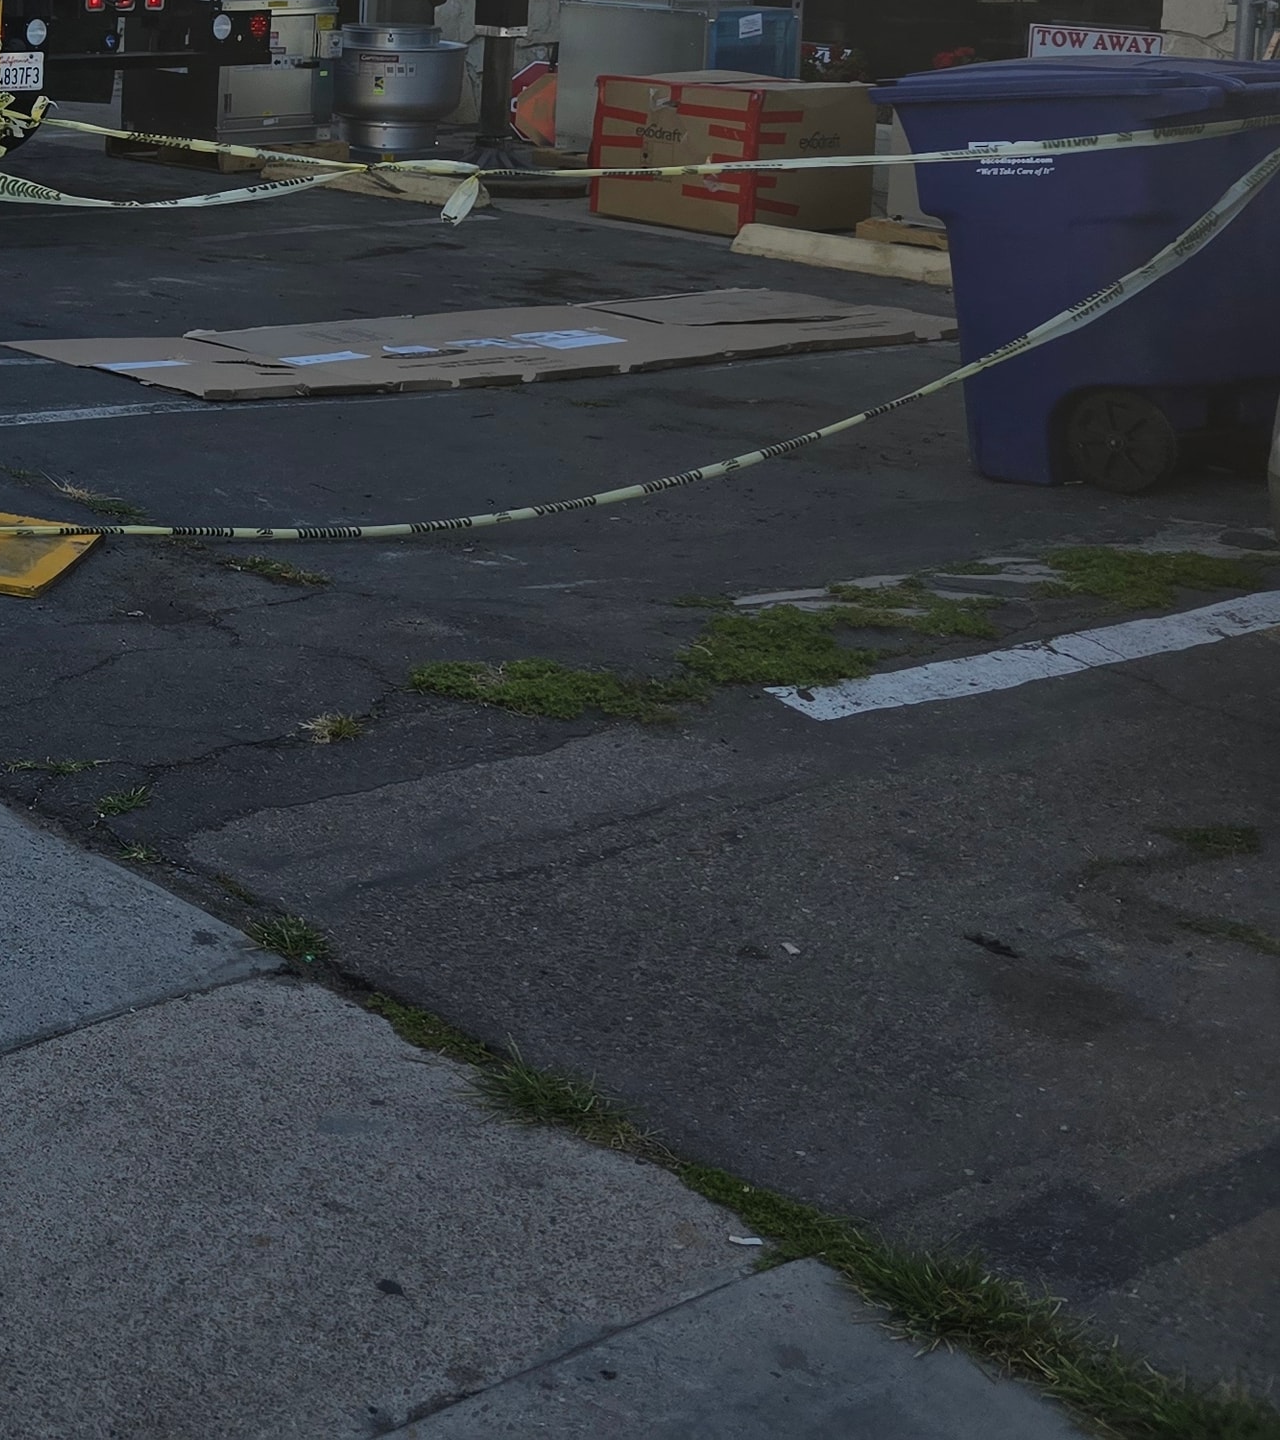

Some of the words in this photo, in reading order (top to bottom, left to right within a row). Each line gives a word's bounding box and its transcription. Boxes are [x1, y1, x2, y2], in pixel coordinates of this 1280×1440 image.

[1037, 29, 1089, 49] TOW
[1093, 34, 1157, 54] AWAY
[635, 123, 684, 143] exodraft
[1016, 167, 1033, 175] Care
